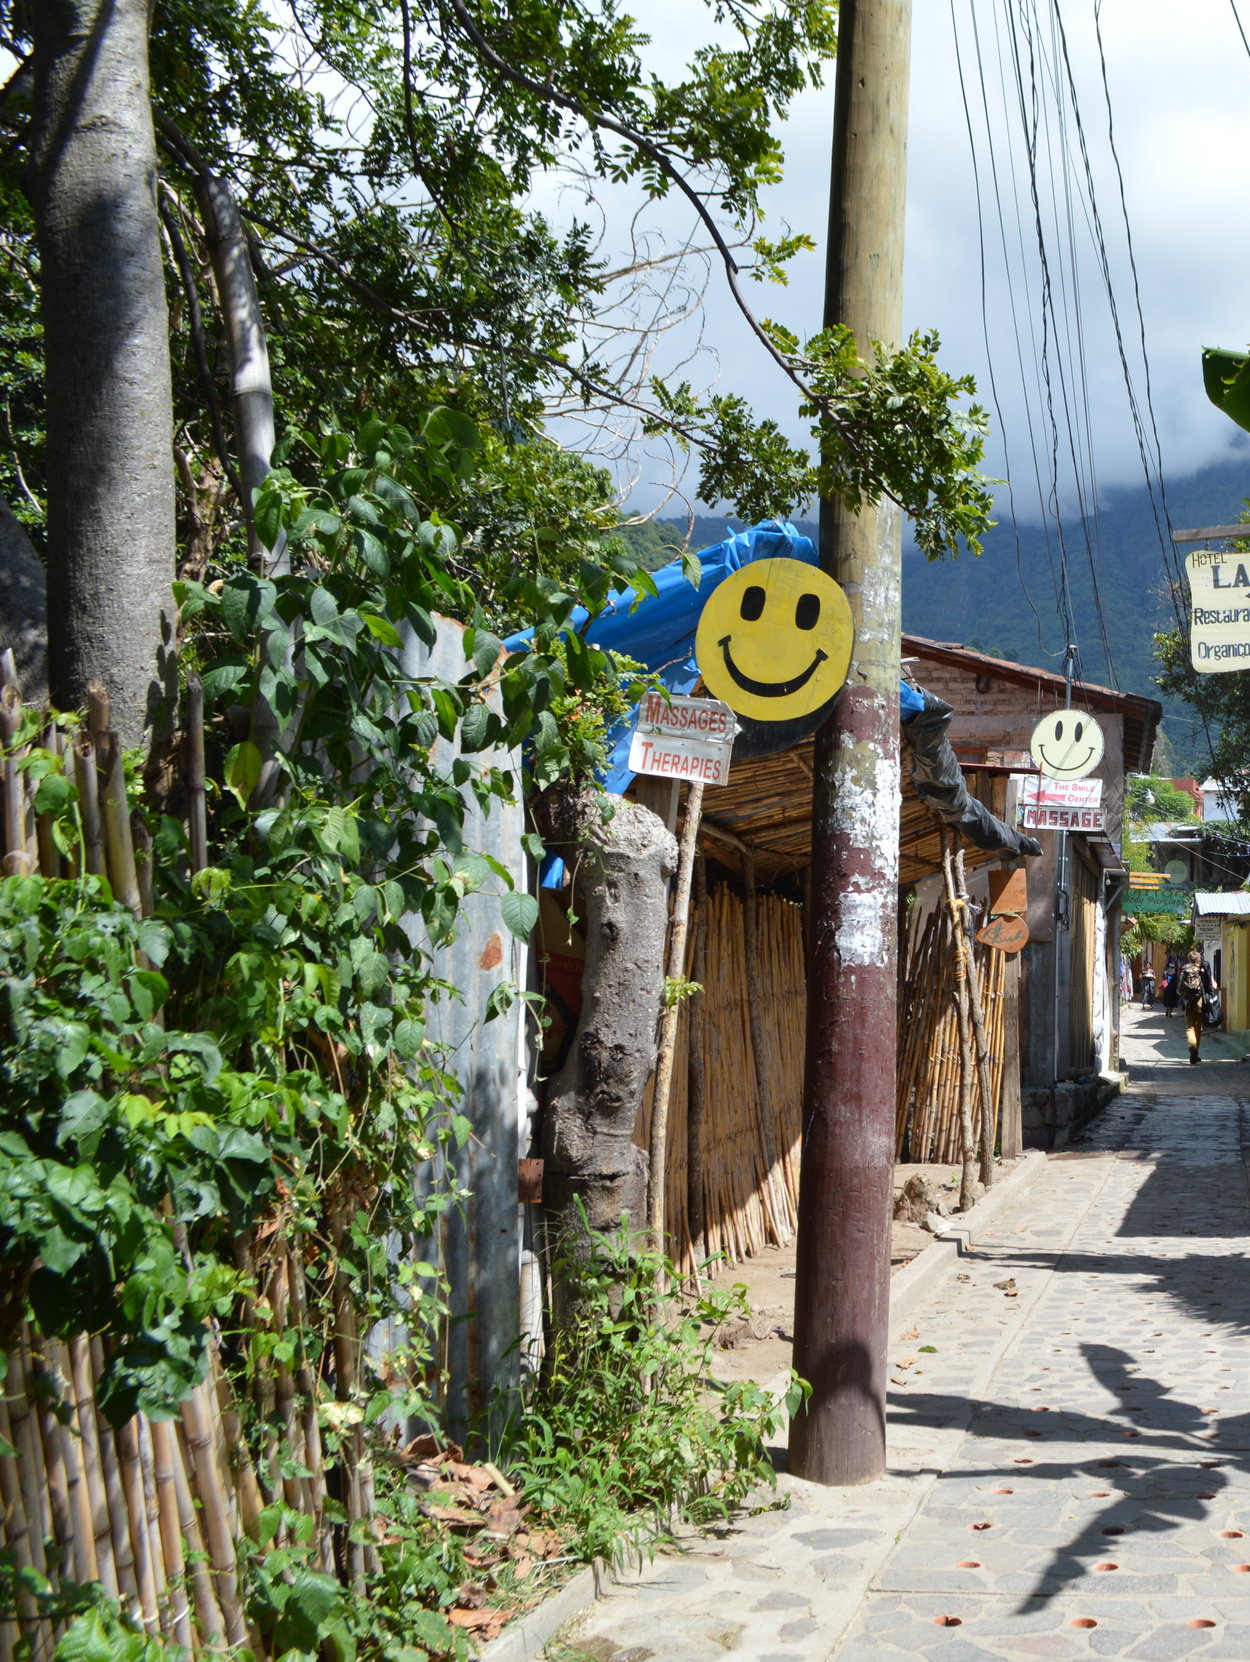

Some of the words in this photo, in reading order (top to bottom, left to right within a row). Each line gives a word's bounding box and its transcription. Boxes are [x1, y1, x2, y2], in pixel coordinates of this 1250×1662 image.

[1192, 553, 1227, 568] HOTEL
[645, 694, 727, 733] MASSAGES
[641, 741, 722, 780] THERAPIES
[1053, 782, 1070, 790] THE
[1072, 784, 1095, 792] SMILE
[1067, 794, 1099, 803] CENTER
[1026, 809, 1102, 828] MASSAGE
